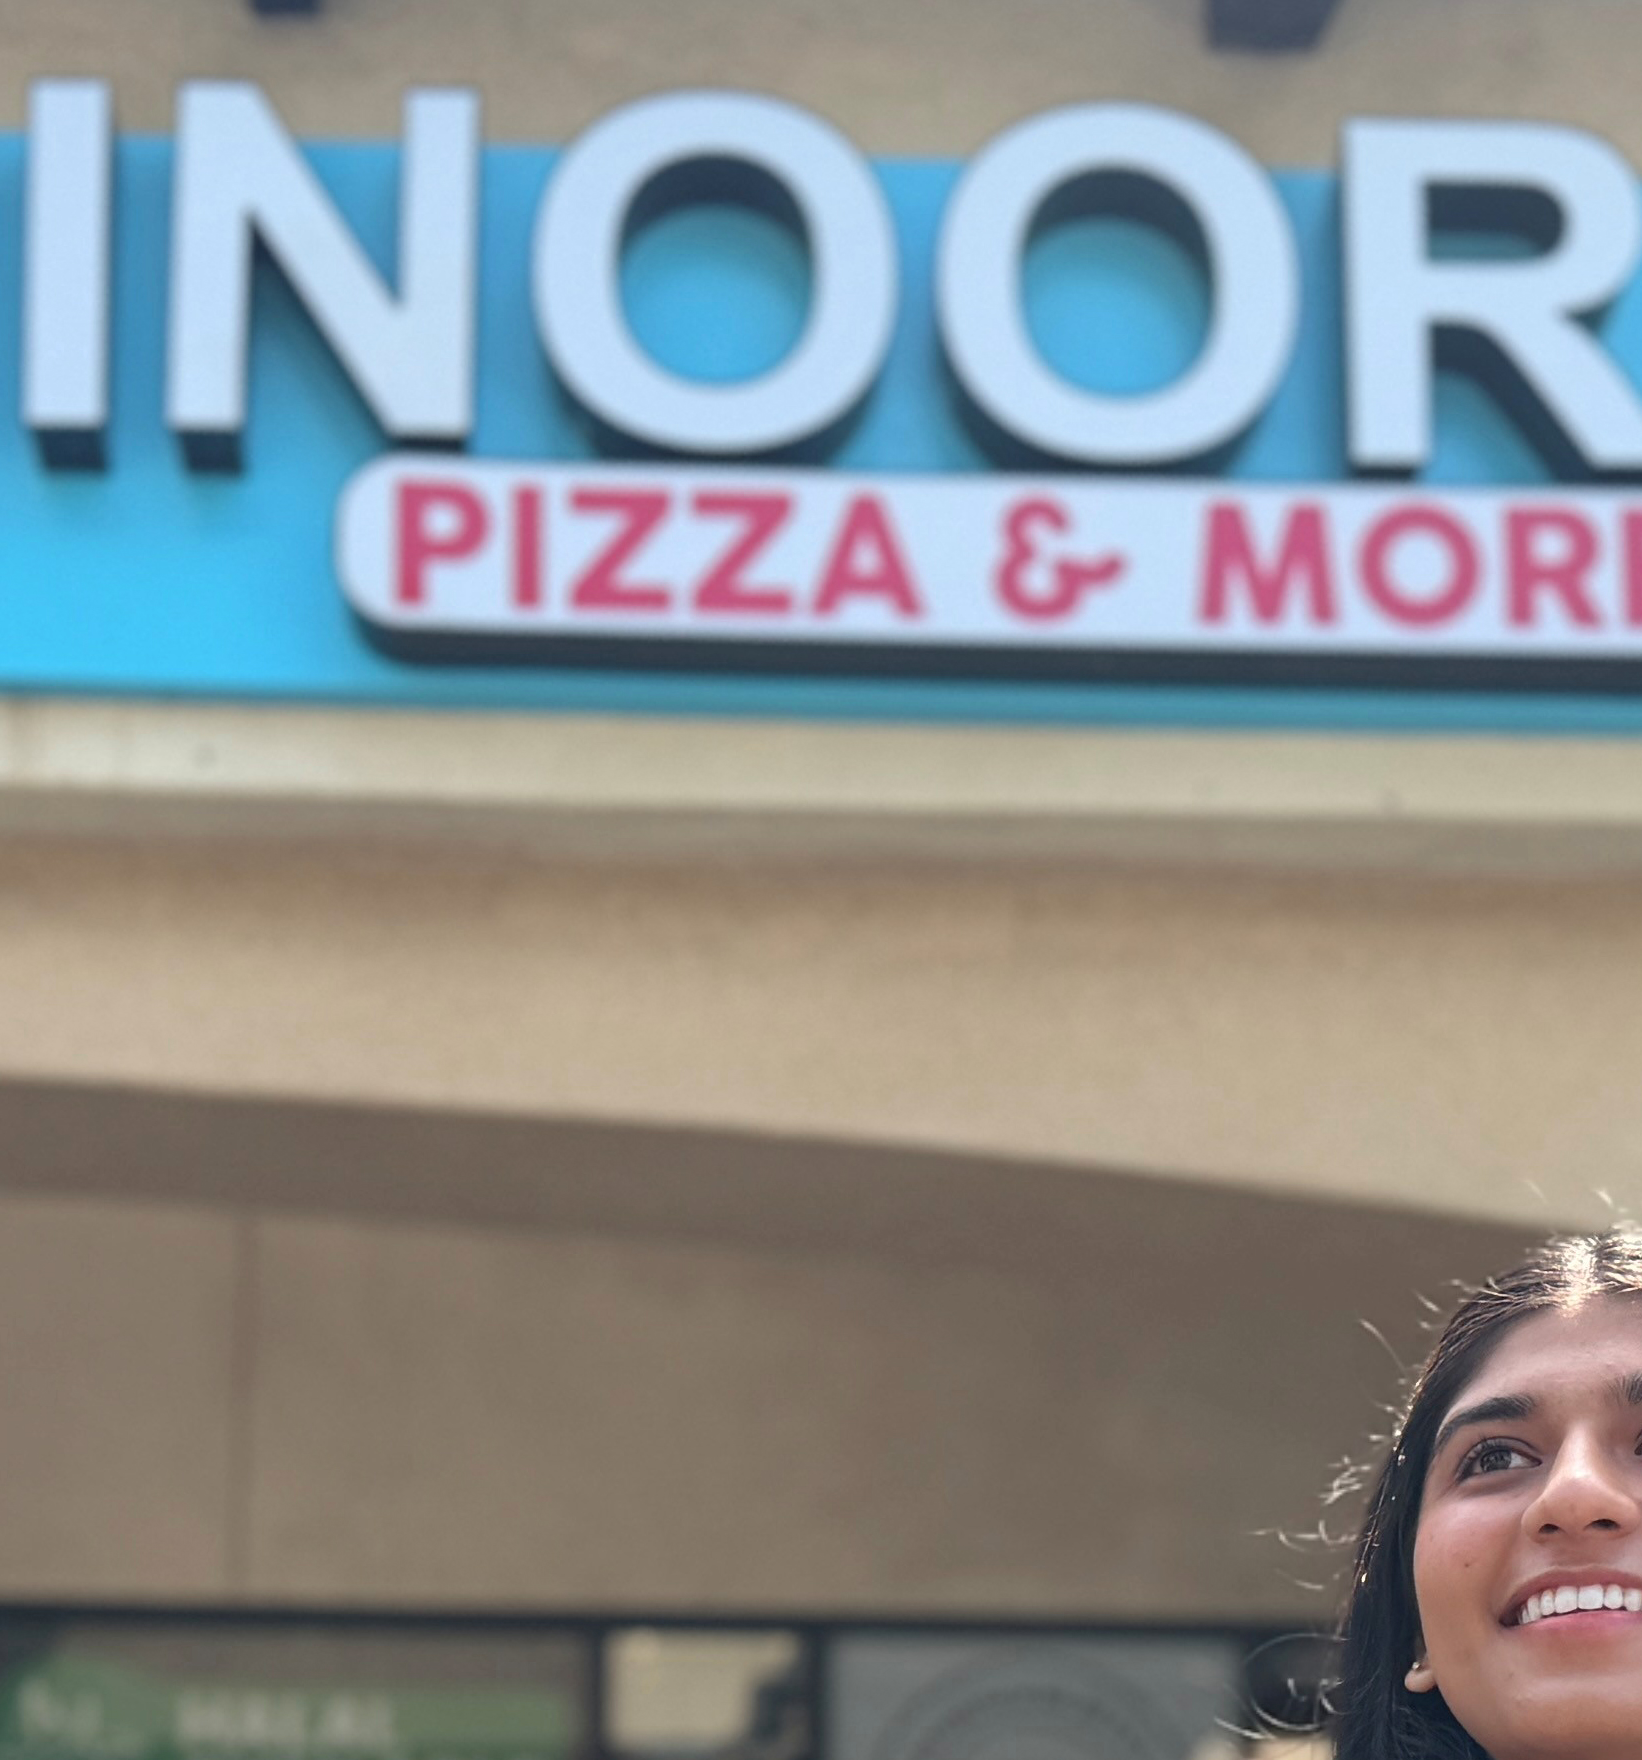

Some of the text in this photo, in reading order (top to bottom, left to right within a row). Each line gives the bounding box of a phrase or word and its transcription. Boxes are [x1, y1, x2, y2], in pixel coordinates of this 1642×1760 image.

[390, 479, 928, 620] PIZZA
[991, 494, 1126, 624] &
[175, 1687, 397, 1748] HALAL
